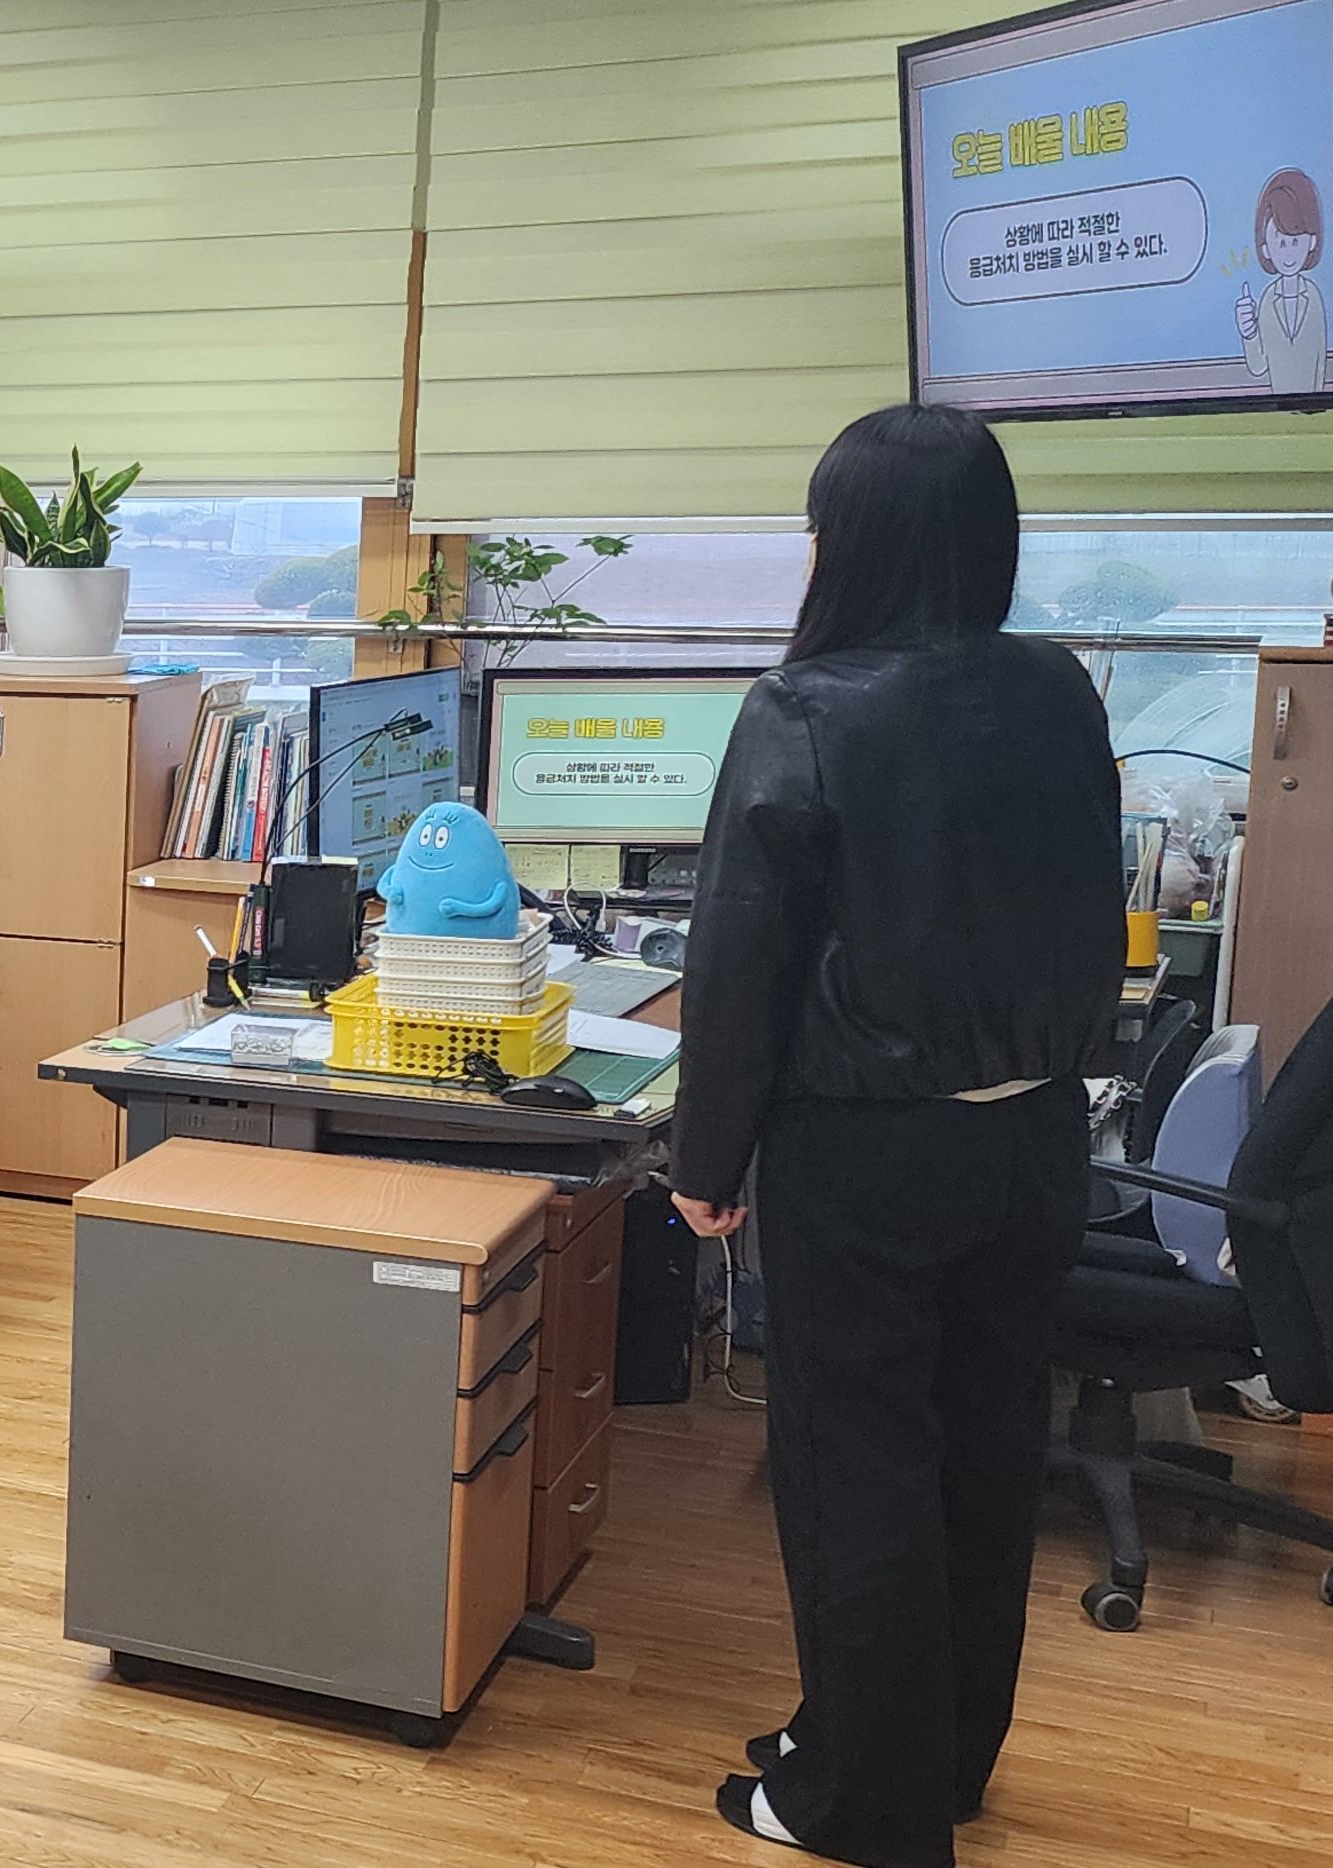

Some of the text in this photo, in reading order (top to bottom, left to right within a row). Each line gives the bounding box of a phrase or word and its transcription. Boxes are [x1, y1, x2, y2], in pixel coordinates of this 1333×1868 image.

[952, 101, 1128, 179] 오늘 배울 내용
[1005, 211, 1120, 248] 상황에 따라 적절한
[969, 233, 1168, 278] 응급처치 방법을 실시 할 수 있다.
[526, 717, 665, 739] 오늘 배울 내용
